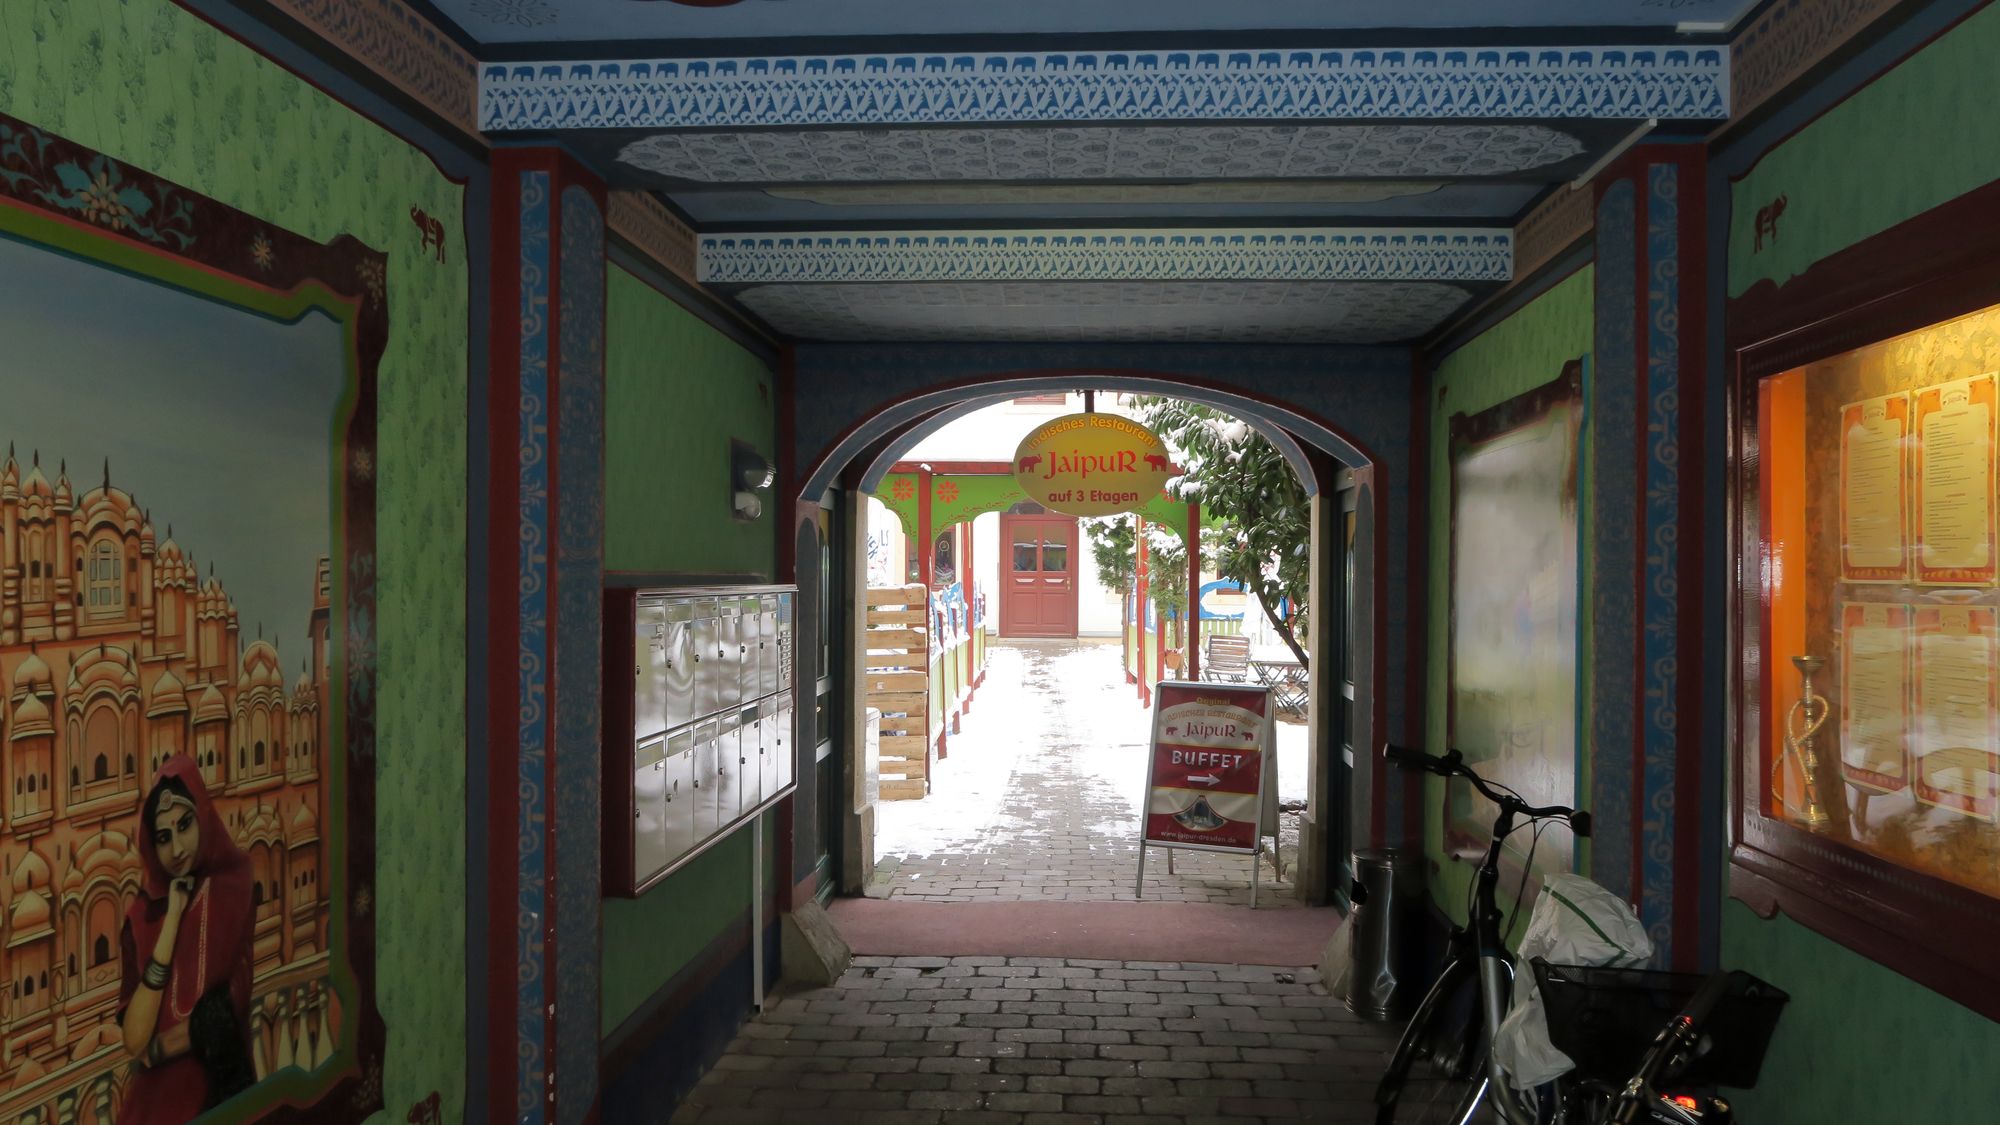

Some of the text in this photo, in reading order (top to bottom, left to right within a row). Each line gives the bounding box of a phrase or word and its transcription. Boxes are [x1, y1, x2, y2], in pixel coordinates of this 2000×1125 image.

[1027, 415, 1158, 449] Indisches Restaurant
[1048, 489, 1138, 505] auf 3 Etagen
[1196, 697, 1231, 706] Original
[1171, 750, 1242, 768] BUFFET
[1160, 831, 1237, 844] www.jaipur-dresden.de
